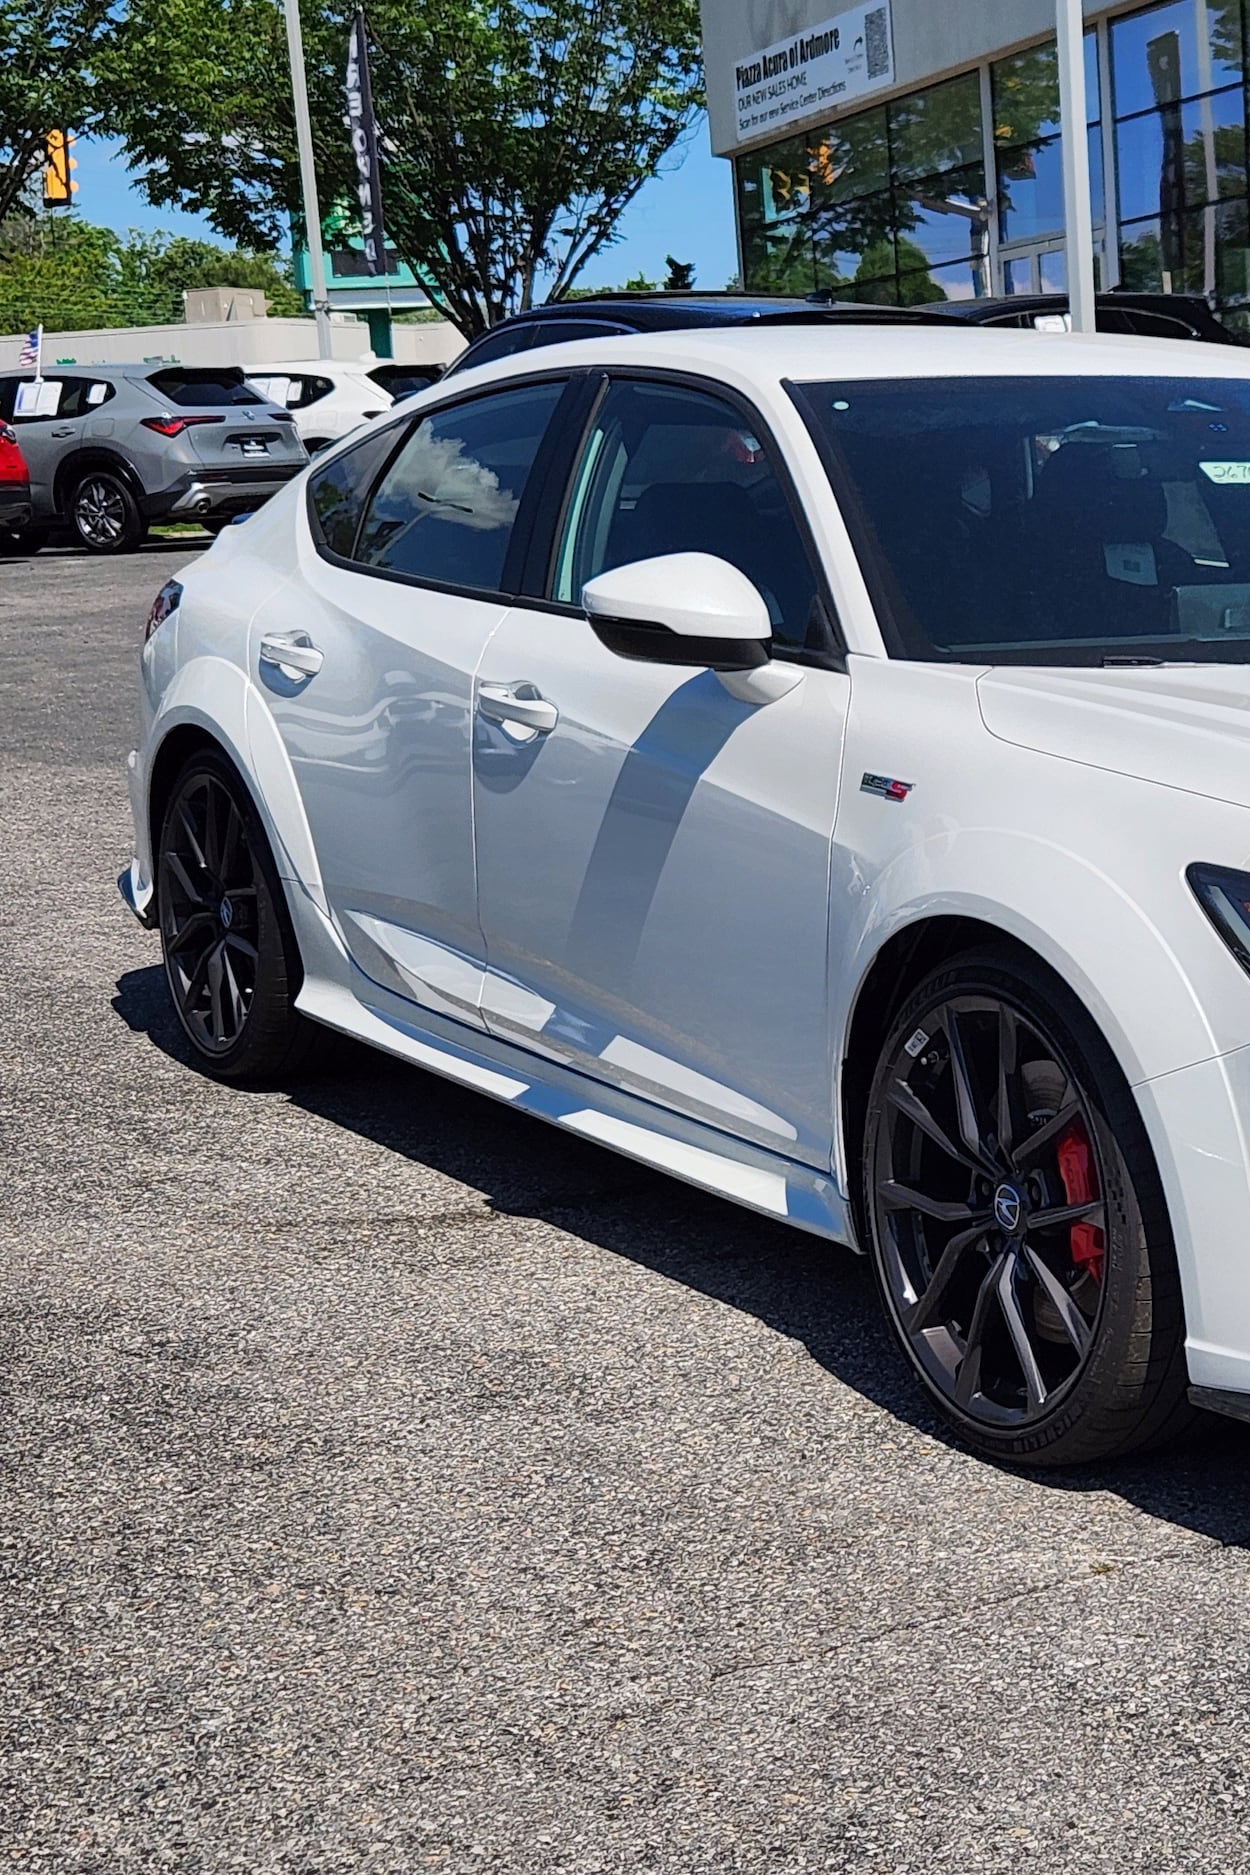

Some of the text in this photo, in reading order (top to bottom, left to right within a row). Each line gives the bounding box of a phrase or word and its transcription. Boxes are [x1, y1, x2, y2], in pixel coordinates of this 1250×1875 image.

[736, 28, 840, 91] Piazza Acura of Ardmore
[738, 70, 807, 112] OUR NEW SALES HOME
[739, 117, 751, 131] Scan
[780, 99, 799, 115] Service
[800, 93, 818, 108] Center
[817, 81, 847, 101] Directions
[1012, 1402, 1085, 1454] MICHELIN
